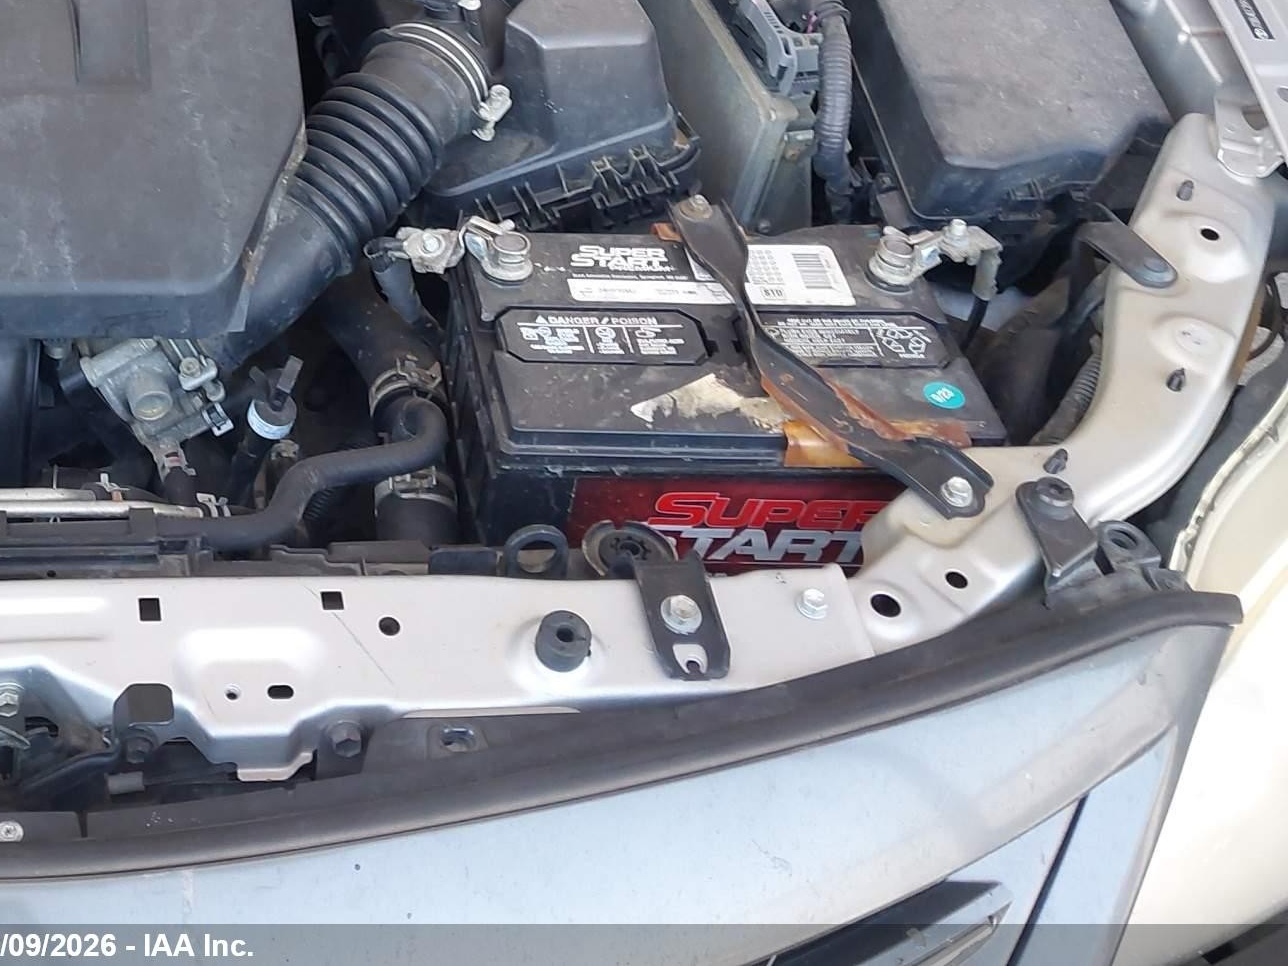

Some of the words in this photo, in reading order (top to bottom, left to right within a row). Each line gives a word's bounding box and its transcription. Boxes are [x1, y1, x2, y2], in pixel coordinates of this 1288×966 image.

[578, 245, 668, 261] SUPER
[570, 254, 669, 269] START
[548, 316, 599, 325] DANGER
[611, 317, 657, 325] POISON
[640, 522, 863, 562] TART
